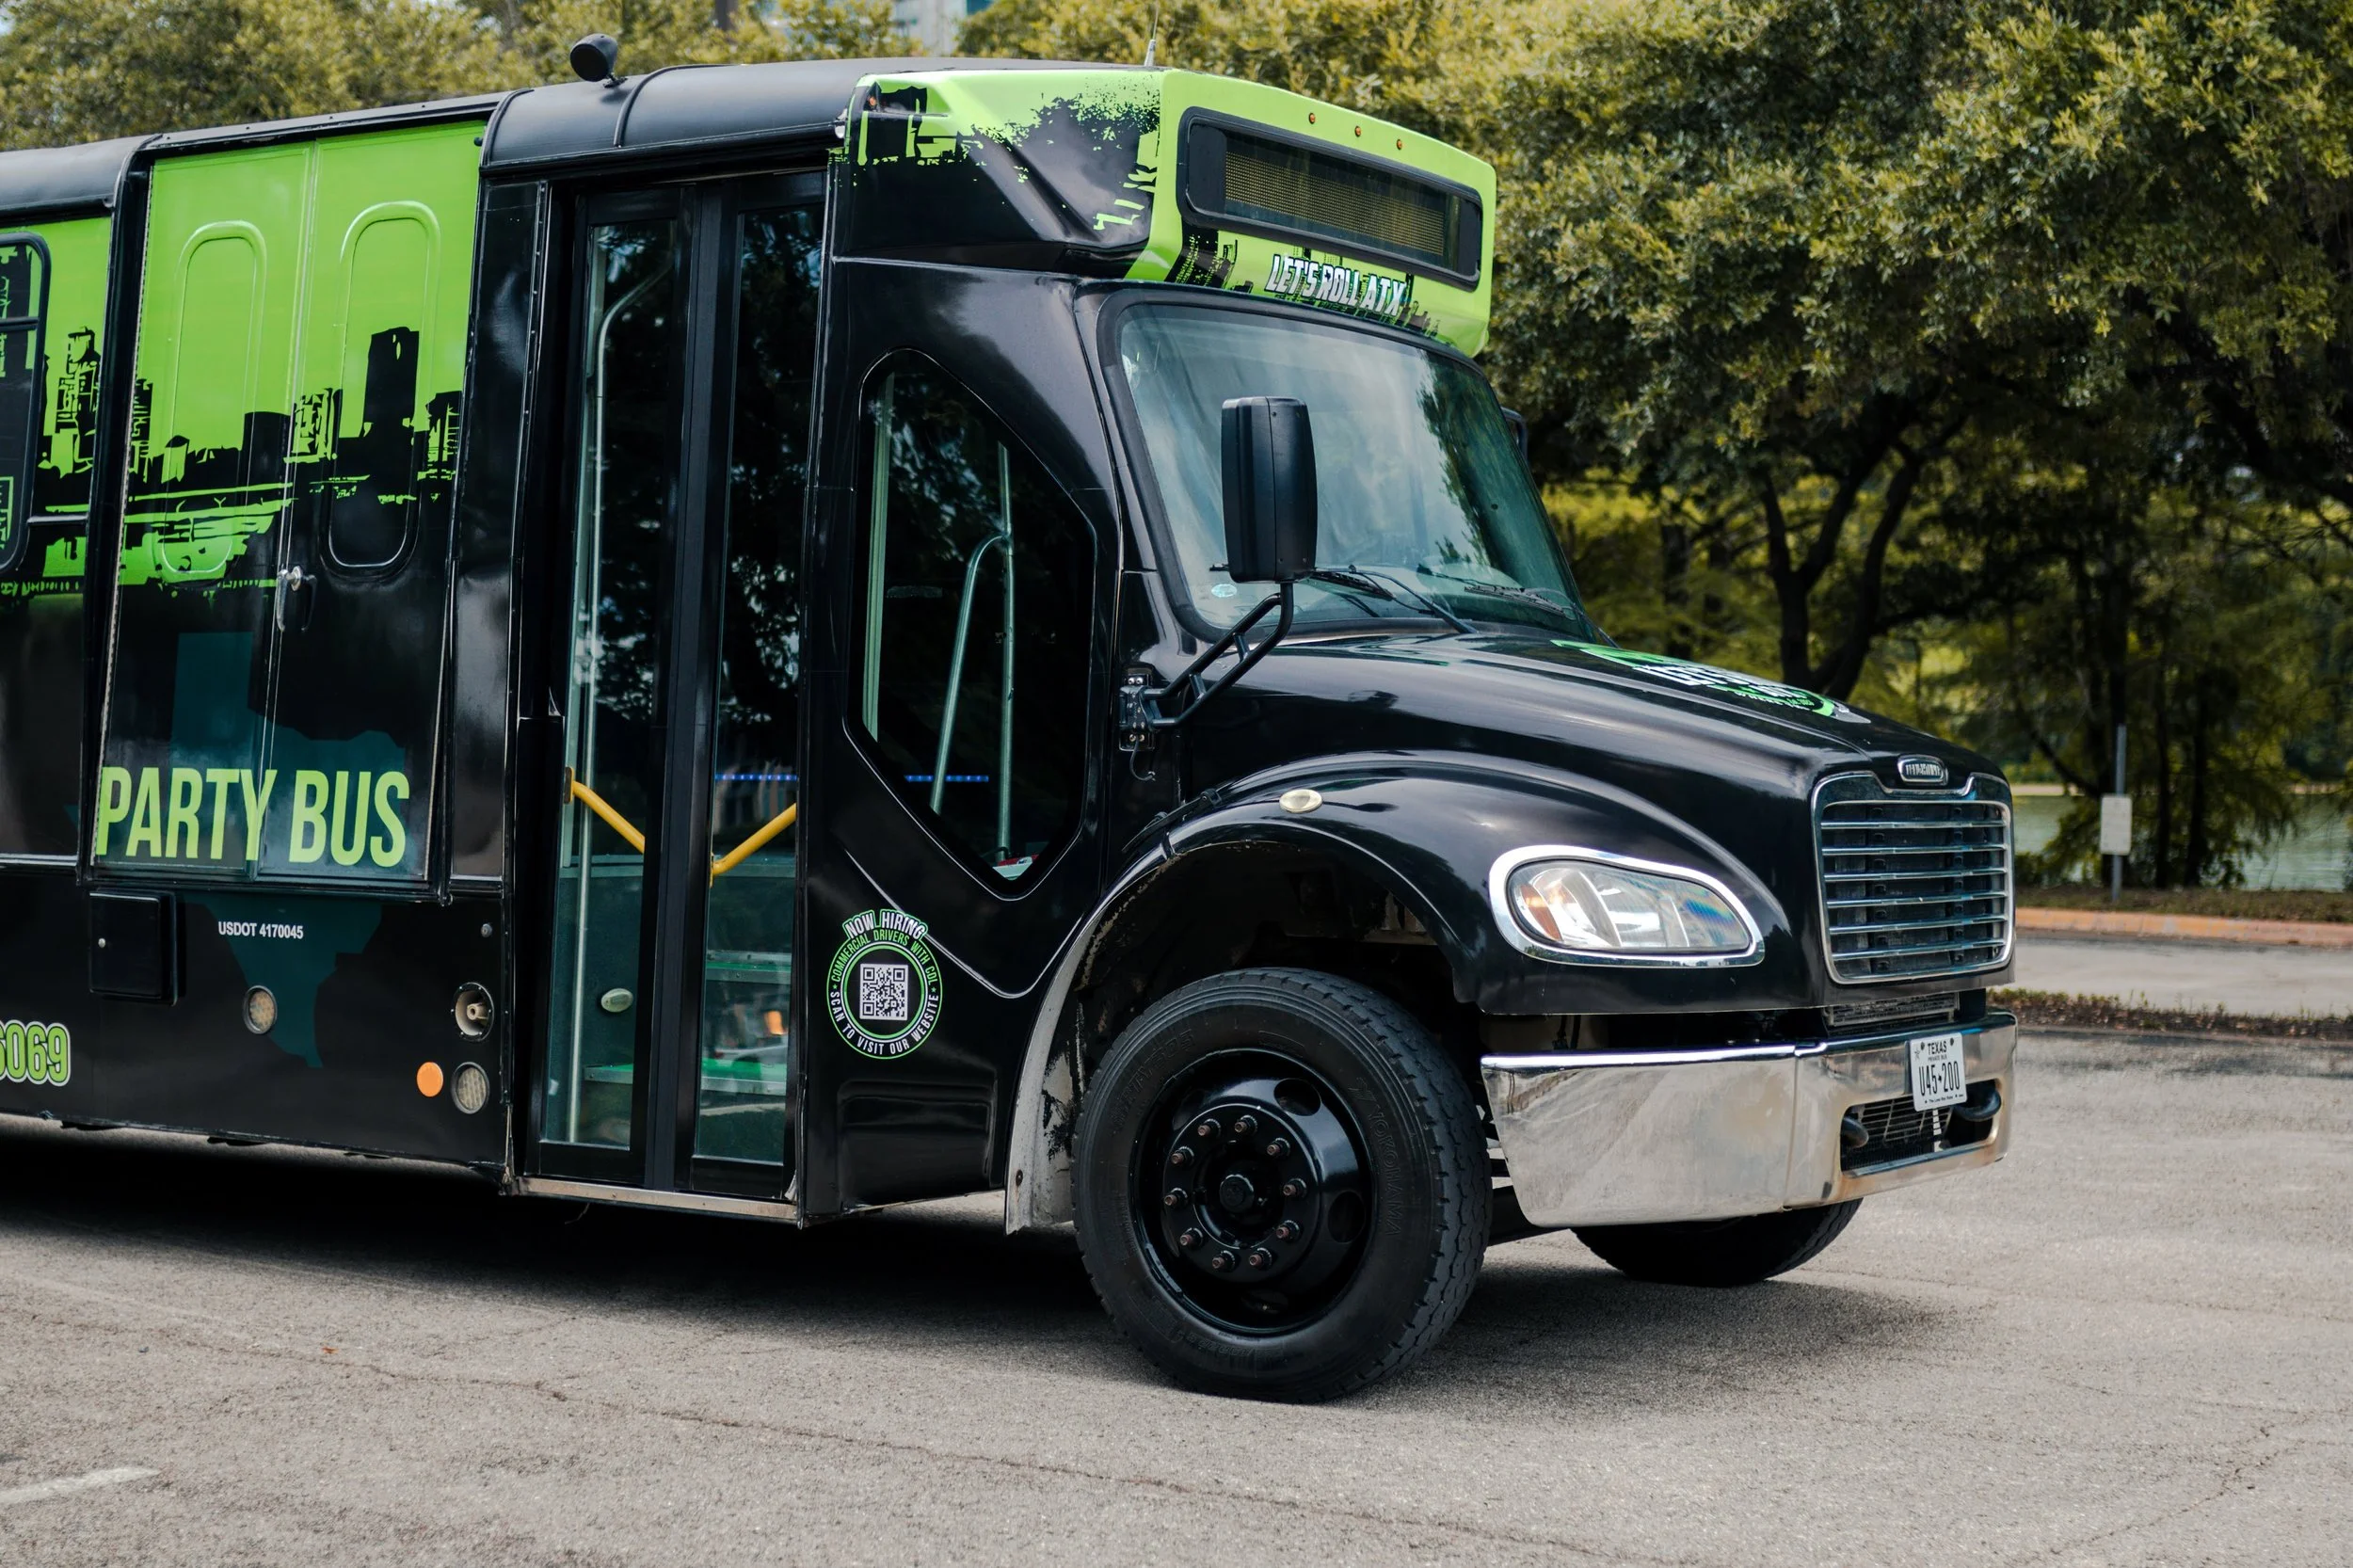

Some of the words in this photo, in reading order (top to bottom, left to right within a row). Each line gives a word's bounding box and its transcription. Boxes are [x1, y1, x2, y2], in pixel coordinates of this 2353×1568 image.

[1265, 254, 1320, 297] LET'S
[1317, 264, 1360, 307] ROLL
[1362, 274, 1408, 317] ATX
[96, 766, 278, 861] PARTY
[289, 769, 410, 867] BUS
[218, 921, 257, 936] USDOT
[259, 923, 304, 939] 4170045
[844, 913, 875, 939] NOW
[881, 911, 926, 940] HIRING
[831, 933, 871, 983] COMMERCIAL
[872, 929, 911, 947] DRIVERS
[910, 940, 931, 969] WITH
[925, 966, 938, 985] CDL
[830, 991, 845, 1023] SCAN
[842, 1023, 856, 1040] TO
[856, 1038, 885, 1055] VISIT
[889, 1039, 910, 1055] OUR
[911, 994, 939, 1042] WEBSITE
[1928, 1040, 1947, 1055] TEXAS
[0, 1019, 71, 1087] 069
